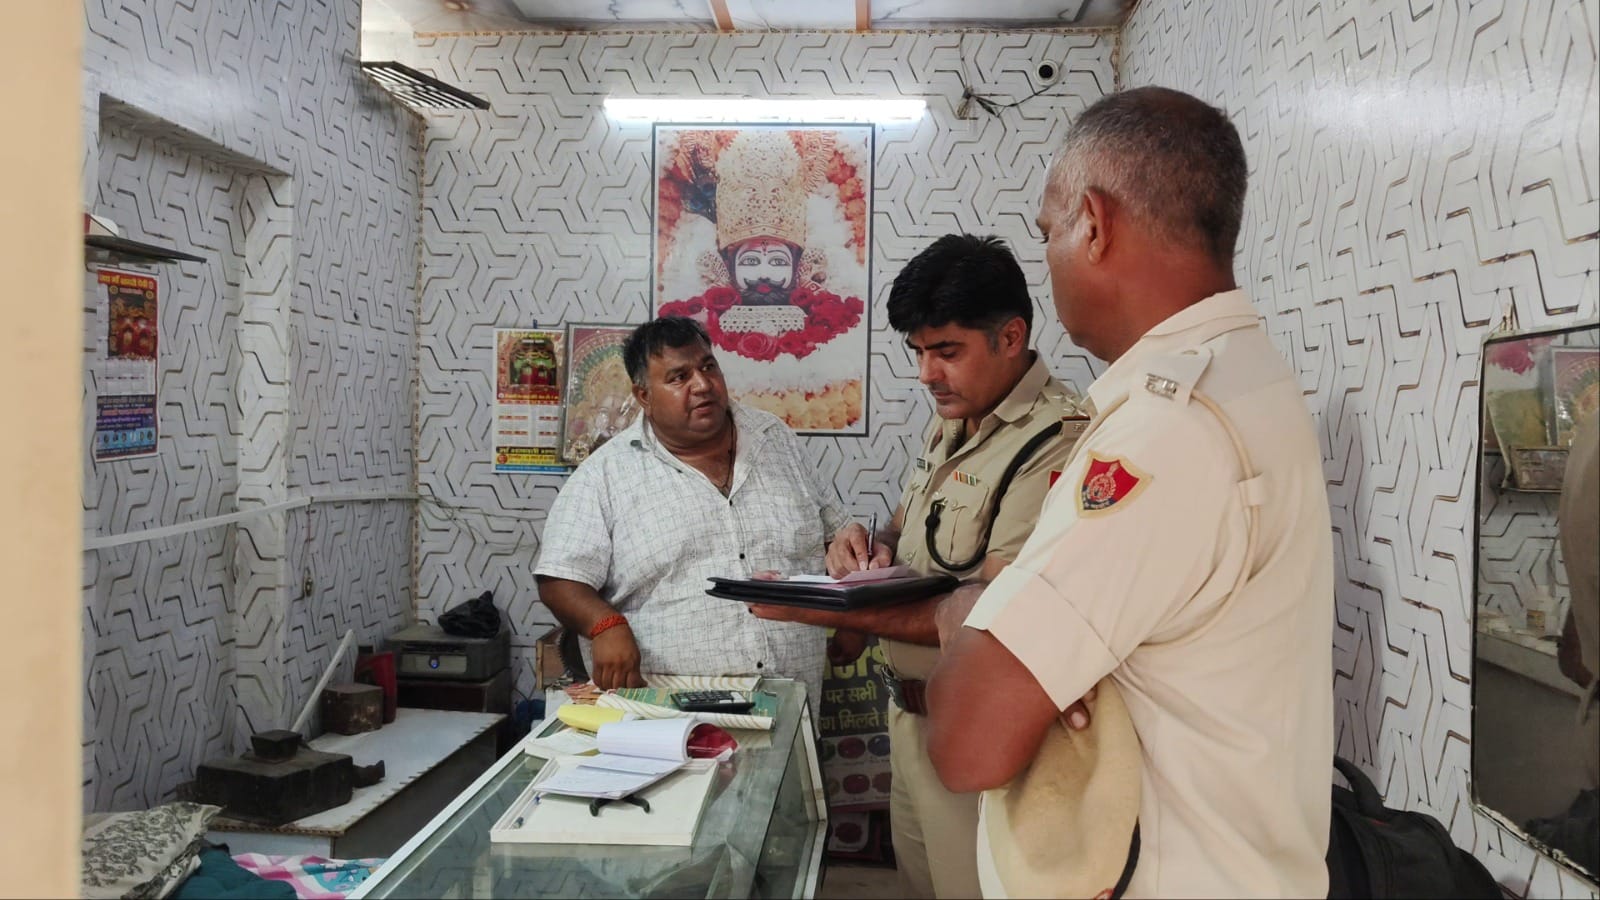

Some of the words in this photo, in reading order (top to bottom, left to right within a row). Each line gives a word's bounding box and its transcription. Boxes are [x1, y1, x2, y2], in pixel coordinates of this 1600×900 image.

[824, 688, 844, 704] पर
[847, 679, 878, 702] सभी
[838, 706, 880, 731] मिलते
